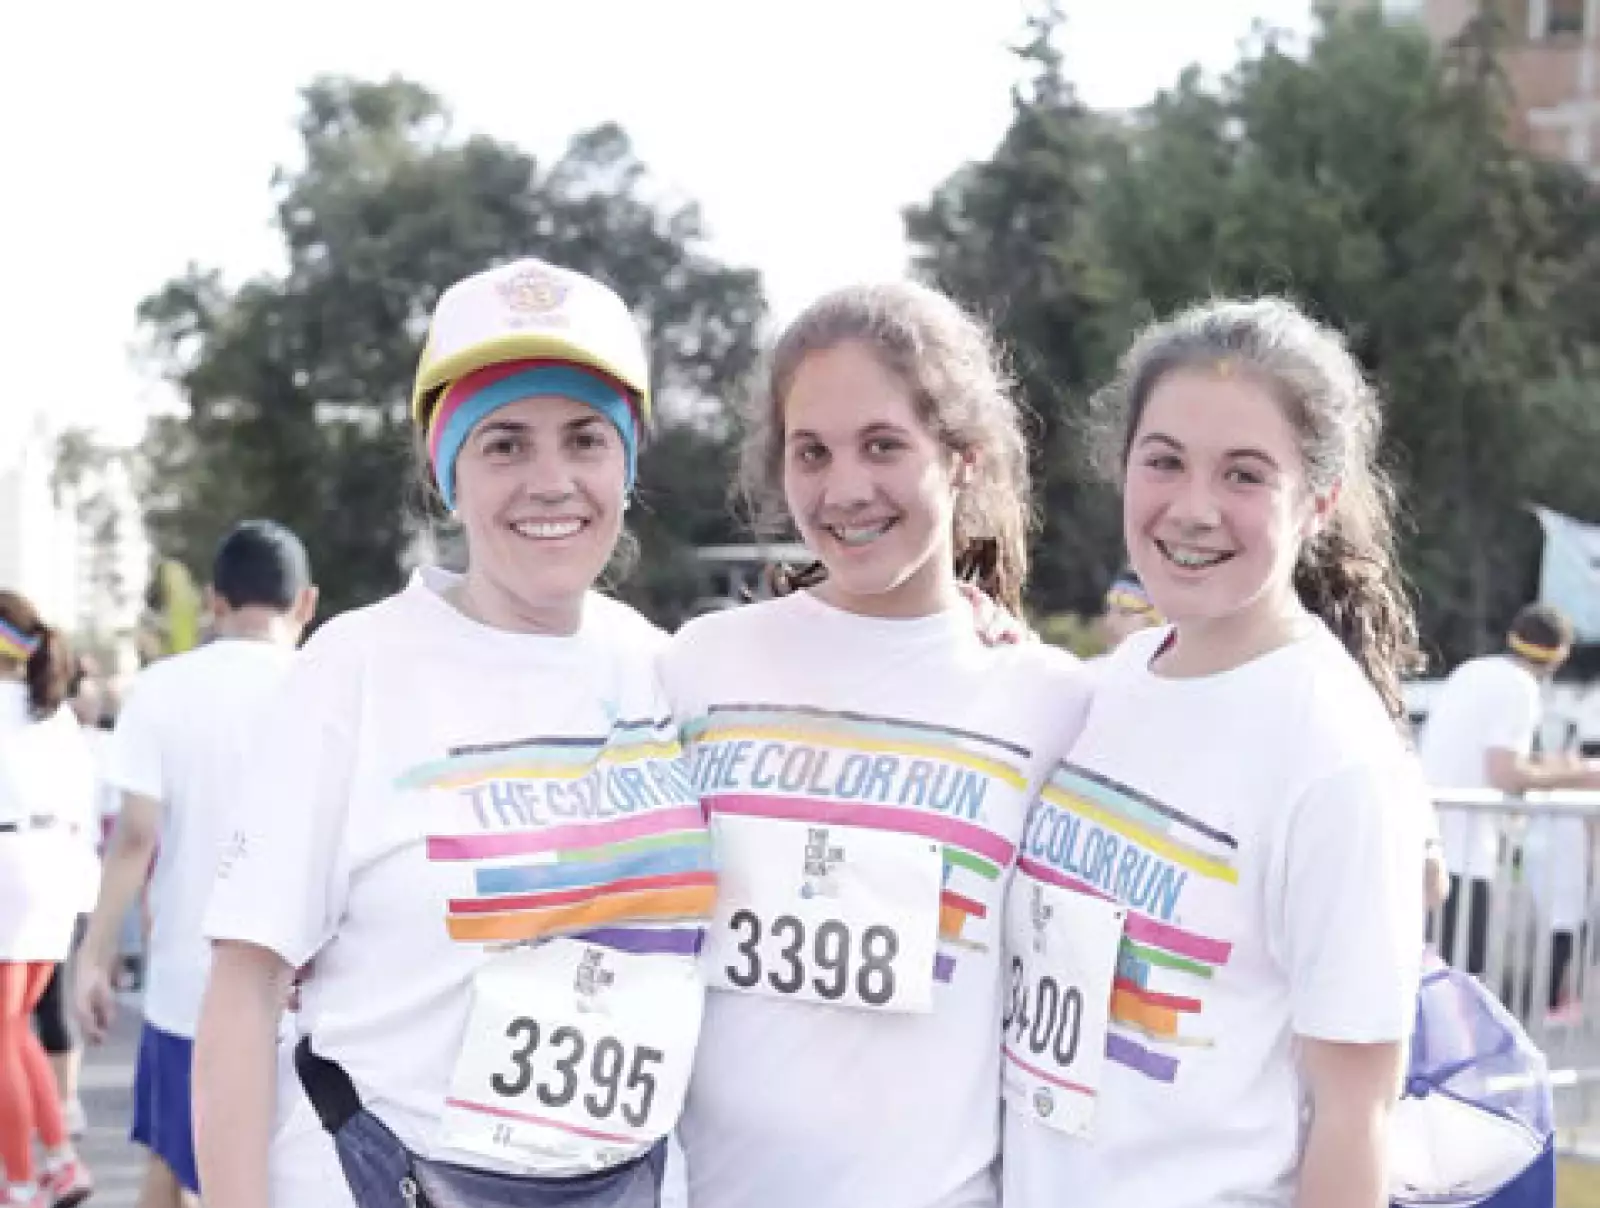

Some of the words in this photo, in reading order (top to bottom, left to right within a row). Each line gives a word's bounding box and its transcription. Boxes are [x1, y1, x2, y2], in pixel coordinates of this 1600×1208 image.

[459, 780, 548, 829] THE
[751, 742, 899, 799] COLOR
[725, 908, 899, 1004] 3398
[490, 1015, 664, 1128] 3395
